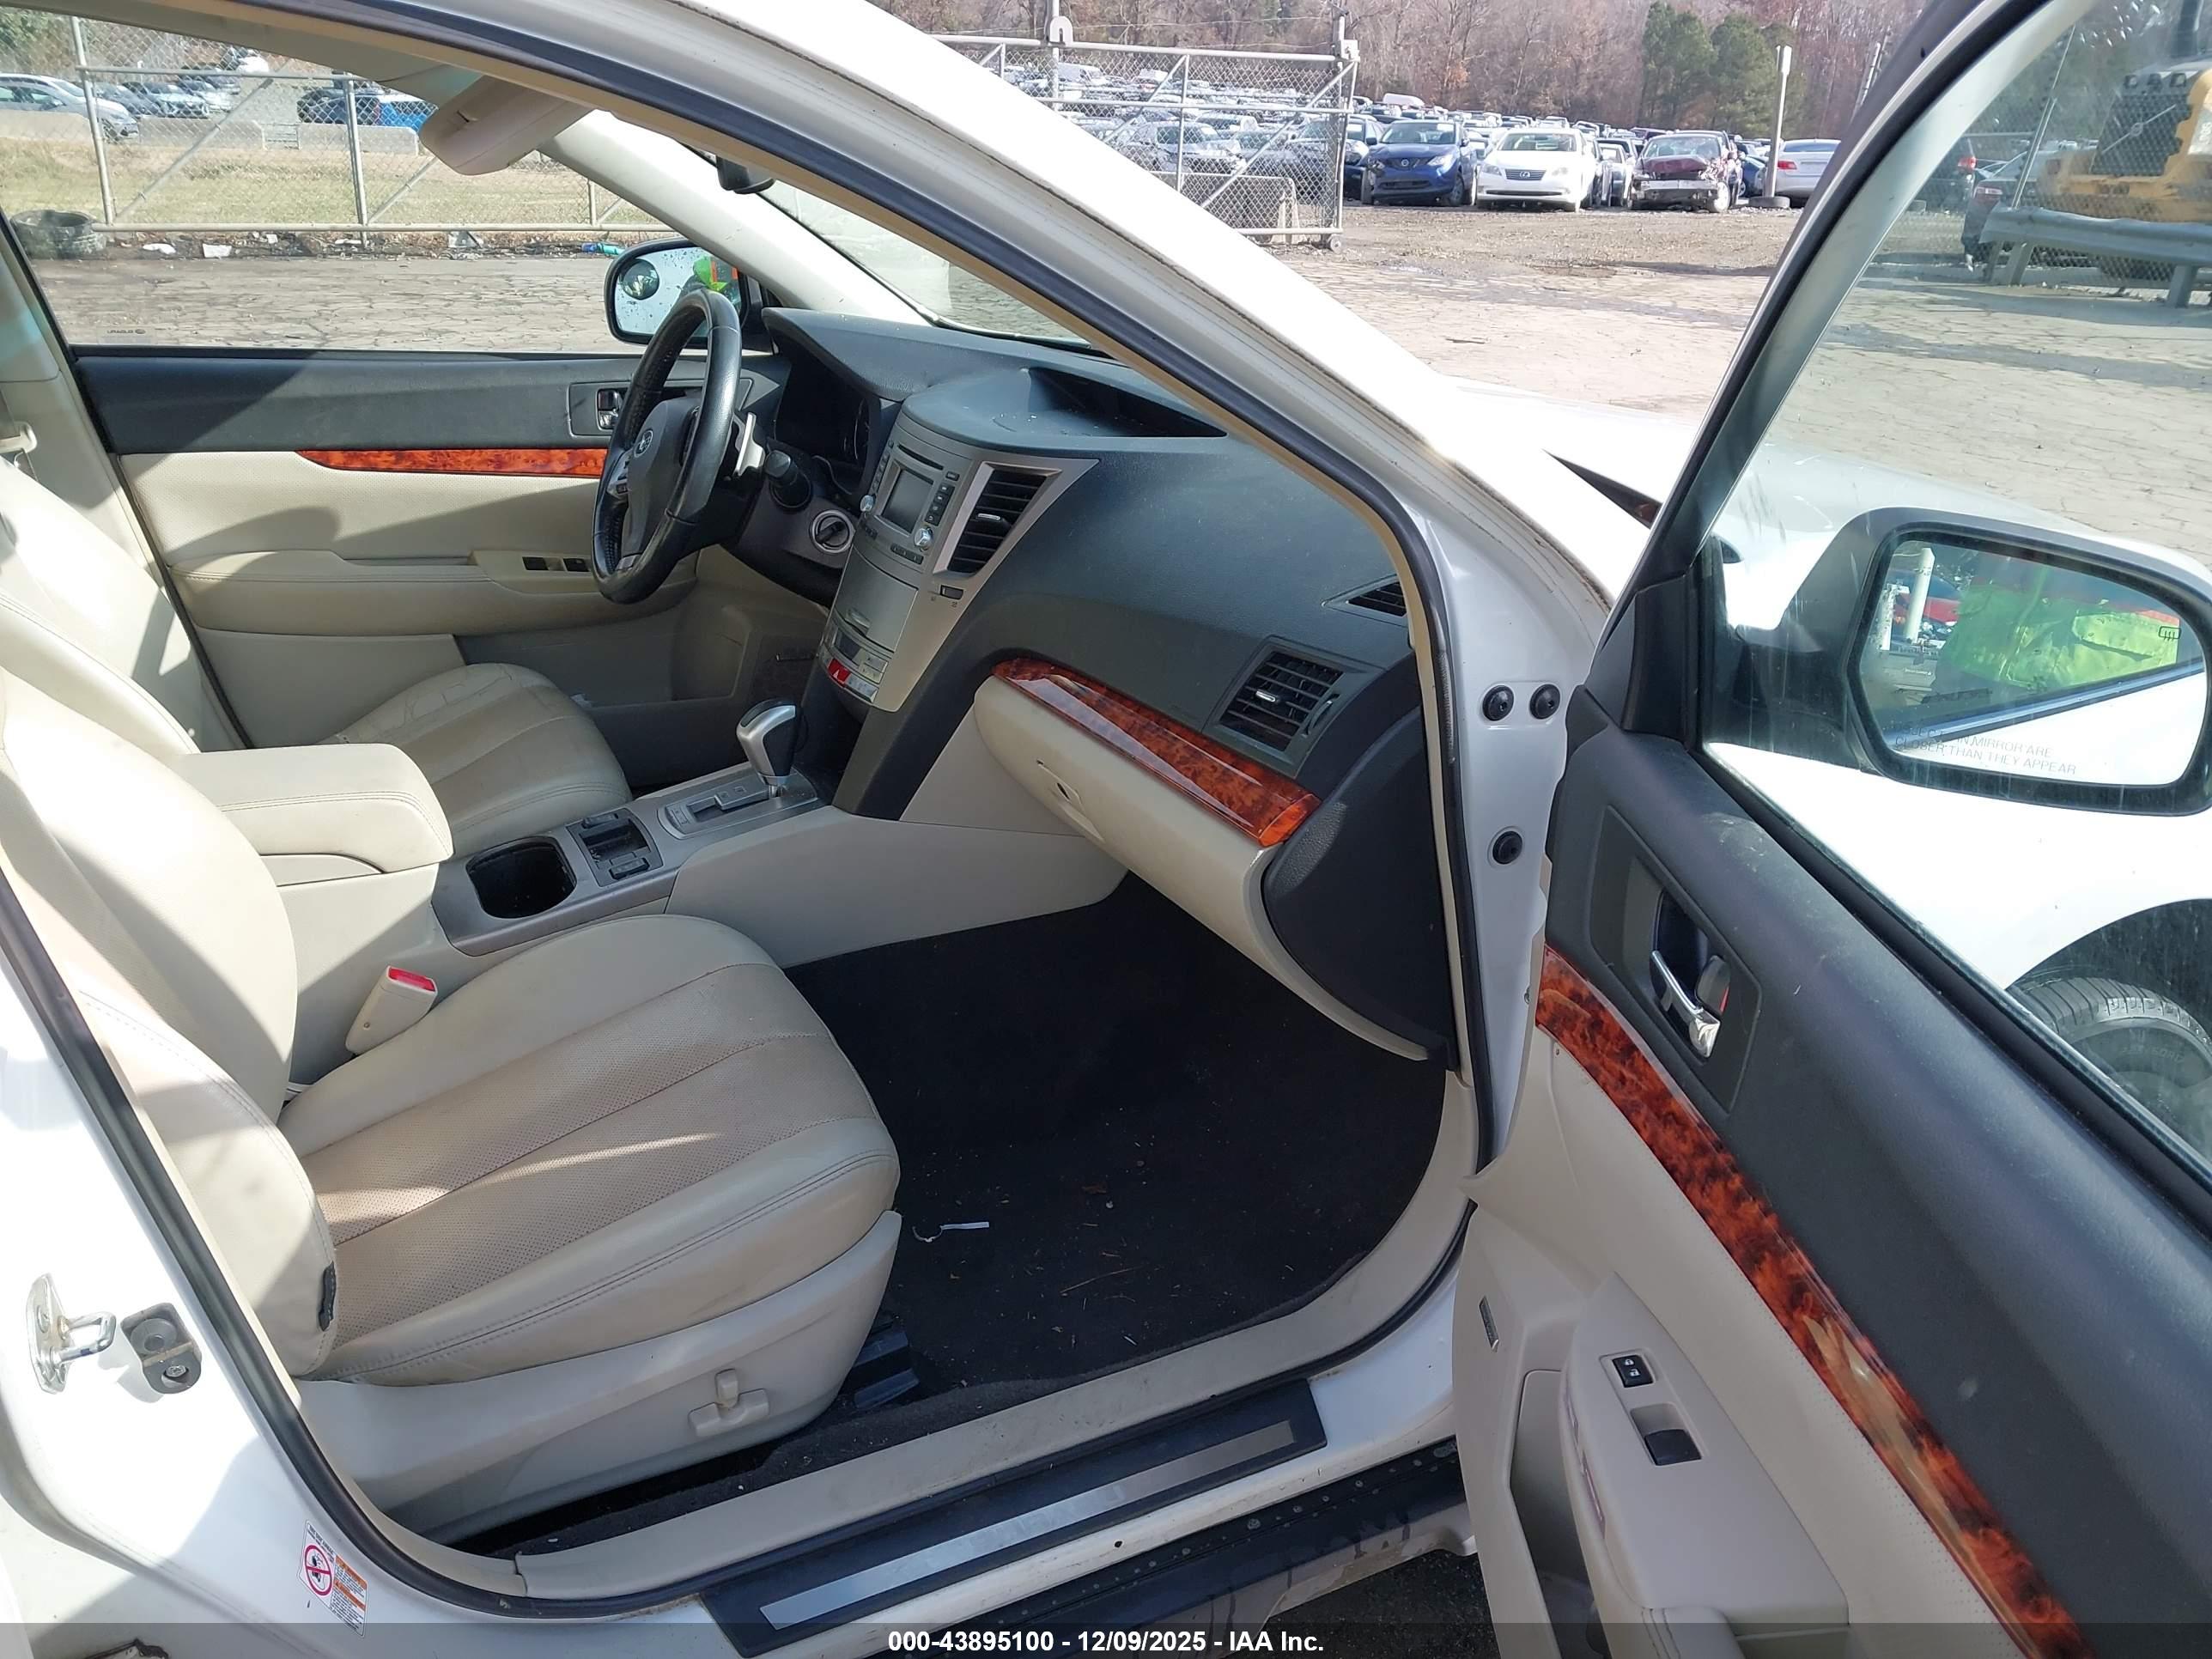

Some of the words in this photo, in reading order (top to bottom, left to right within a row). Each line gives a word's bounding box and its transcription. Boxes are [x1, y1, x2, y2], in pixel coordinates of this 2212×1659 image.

[1949, 745, 1983, 761] THAN
[1988, 751, 2021, 765] THEY
[2022, 757, 2077, 775] APPEAR
[1972, 736, 2024, 752] MIRROR
[2026, 744, 2054, 758] ARE
